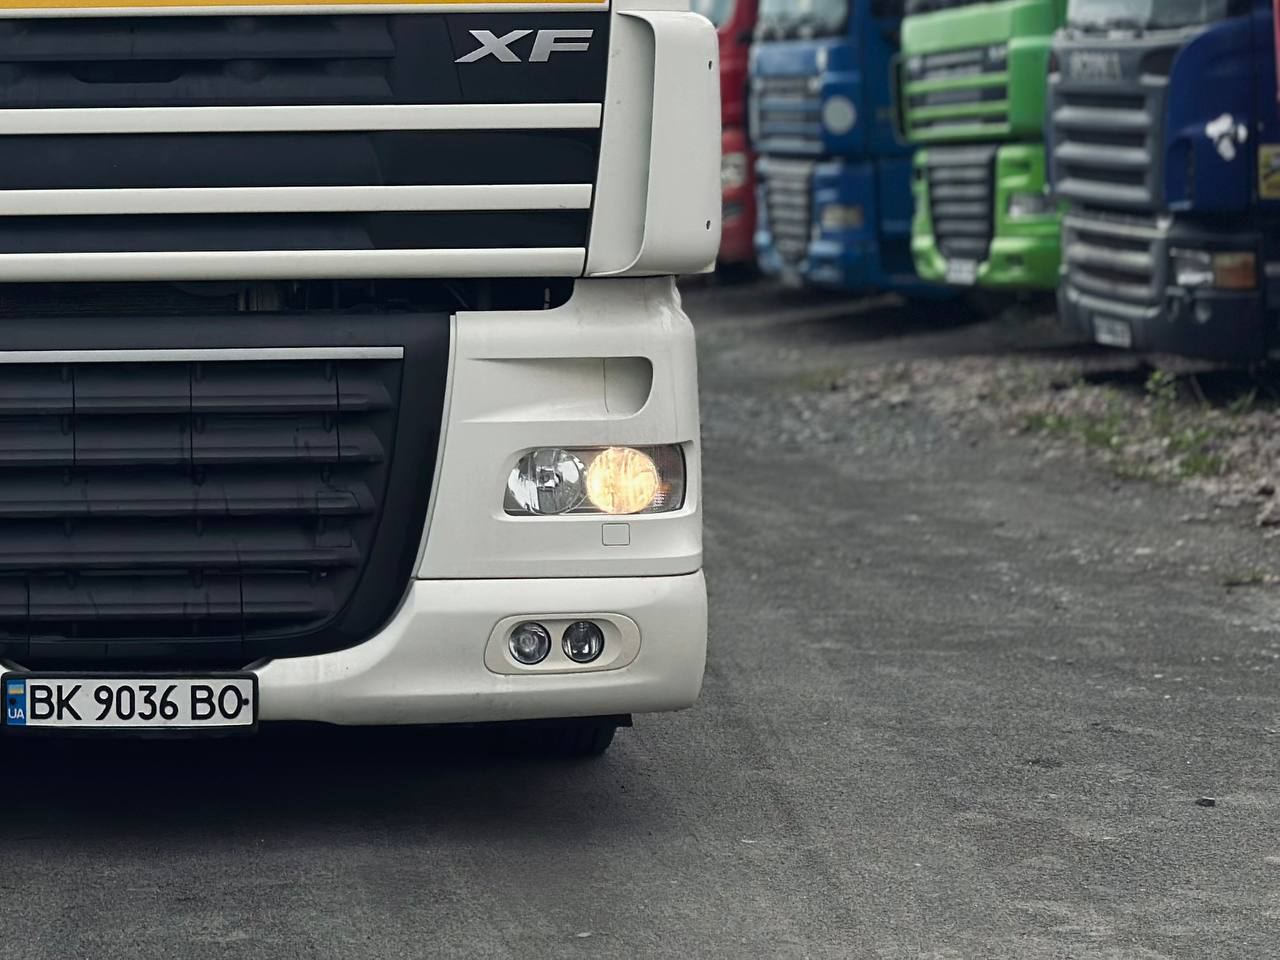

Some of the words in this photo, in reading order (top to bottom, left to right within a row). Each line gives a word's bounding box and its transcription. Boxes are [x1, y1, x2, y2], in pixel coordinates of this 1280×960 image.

[453, 28, 595, 63] XF
[7, 707, 25, 720] UA
[29, 684, 83, 721] BK
[93, 684, 179, 721] 9036
[189, 684, 244, 721] BO
